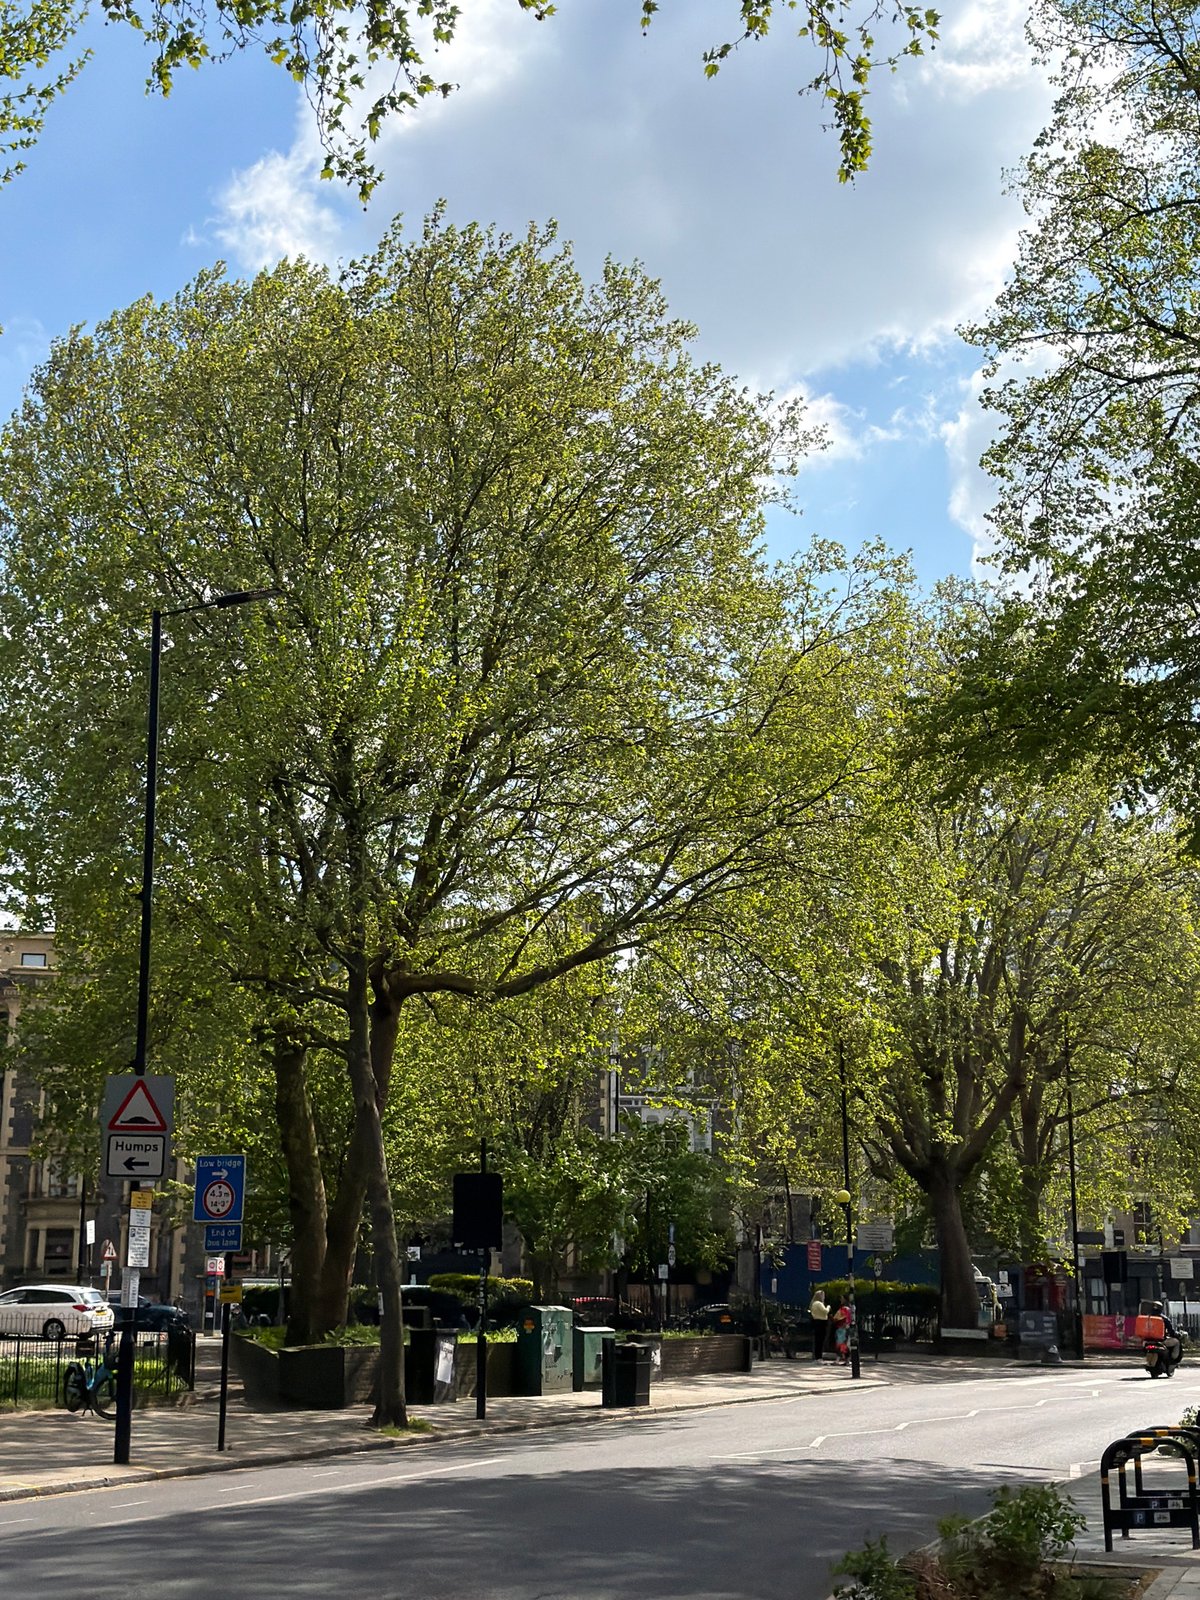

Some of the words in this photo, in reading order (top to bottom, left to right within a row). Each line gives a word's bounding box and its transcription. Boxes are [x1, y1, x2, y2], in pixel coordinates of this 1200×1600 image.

[115, 1140, 159, 1153] Humps
[199, 1160, 215, 1168] Low
[217, 1159, 242, 1169] bridge
[211, 1229, 225, 1237] End
[227, 1229, 235, 1237] of
[207, 1239, 220, 1247] bus
[222, 1239, 238, 1247] lane
